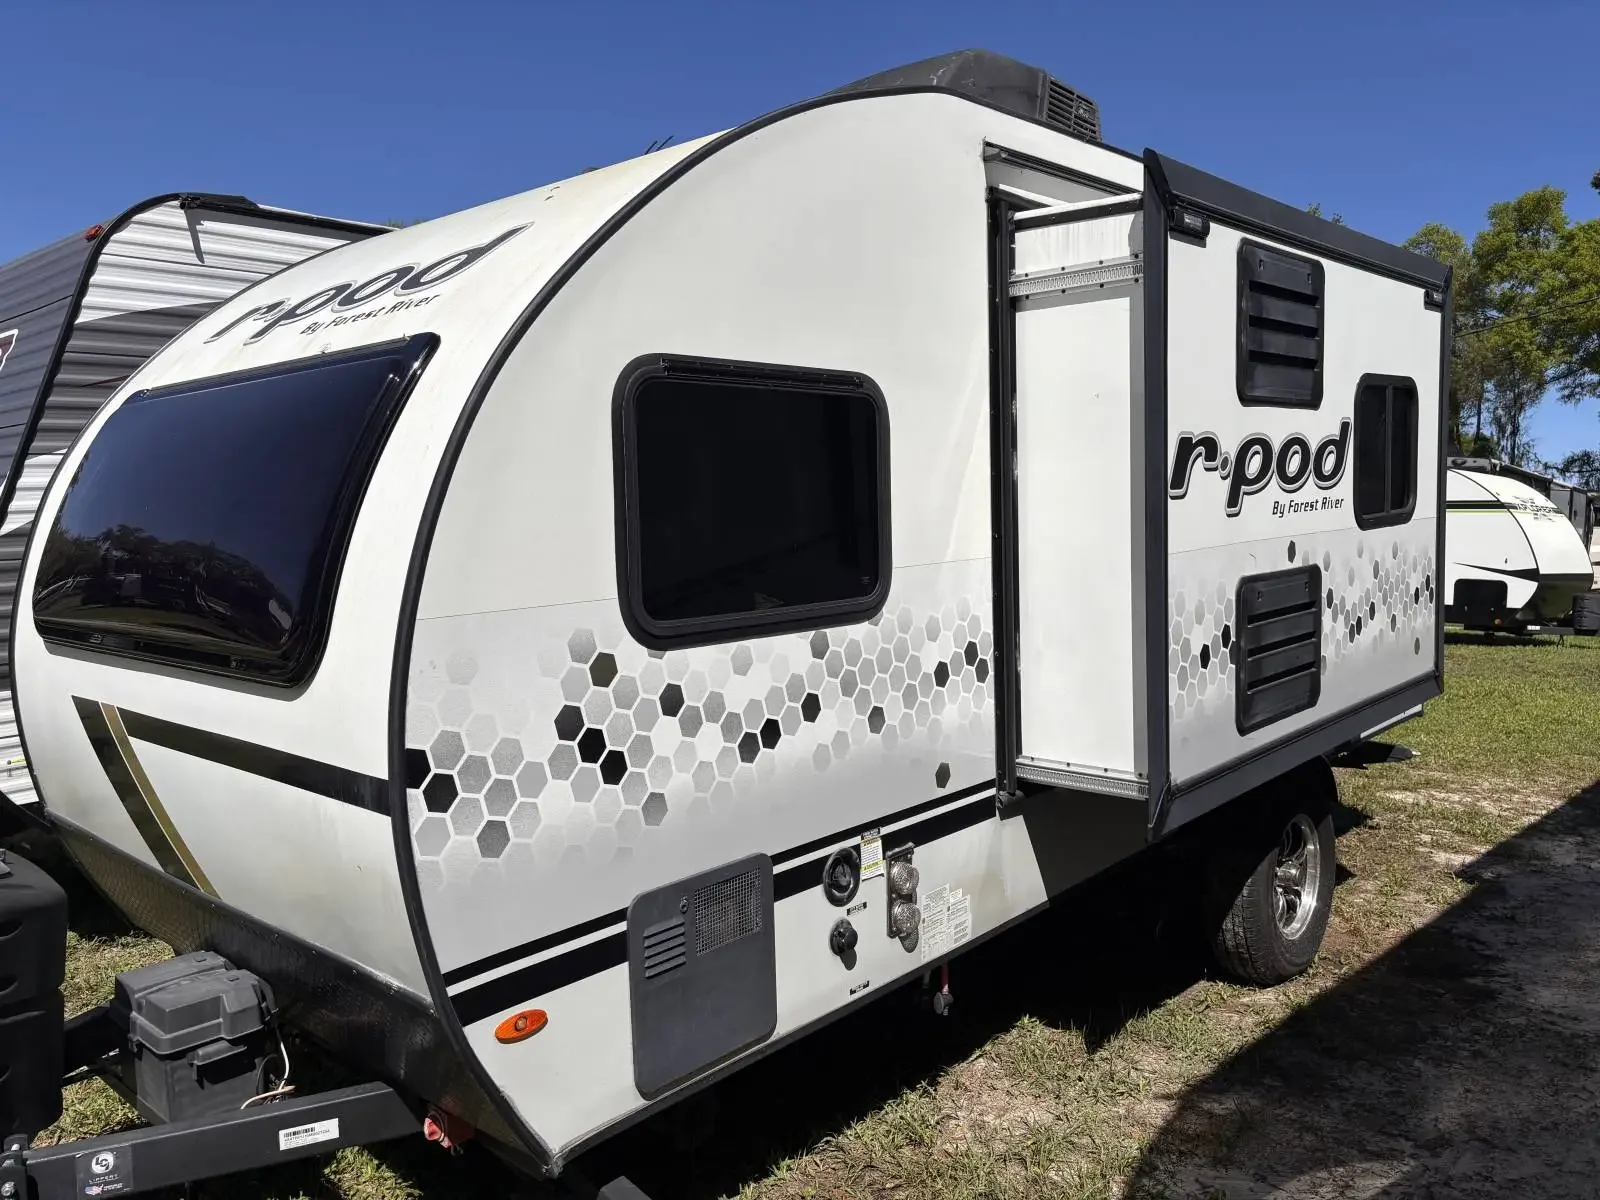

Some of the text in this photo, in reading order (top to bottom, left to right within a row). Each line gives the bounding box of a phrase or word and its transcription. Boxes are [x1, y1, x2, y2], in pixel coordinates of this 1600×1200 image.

[300, 294, 440, 335] By Forest River
[1272, 496, 1344, 518] By Forest River
